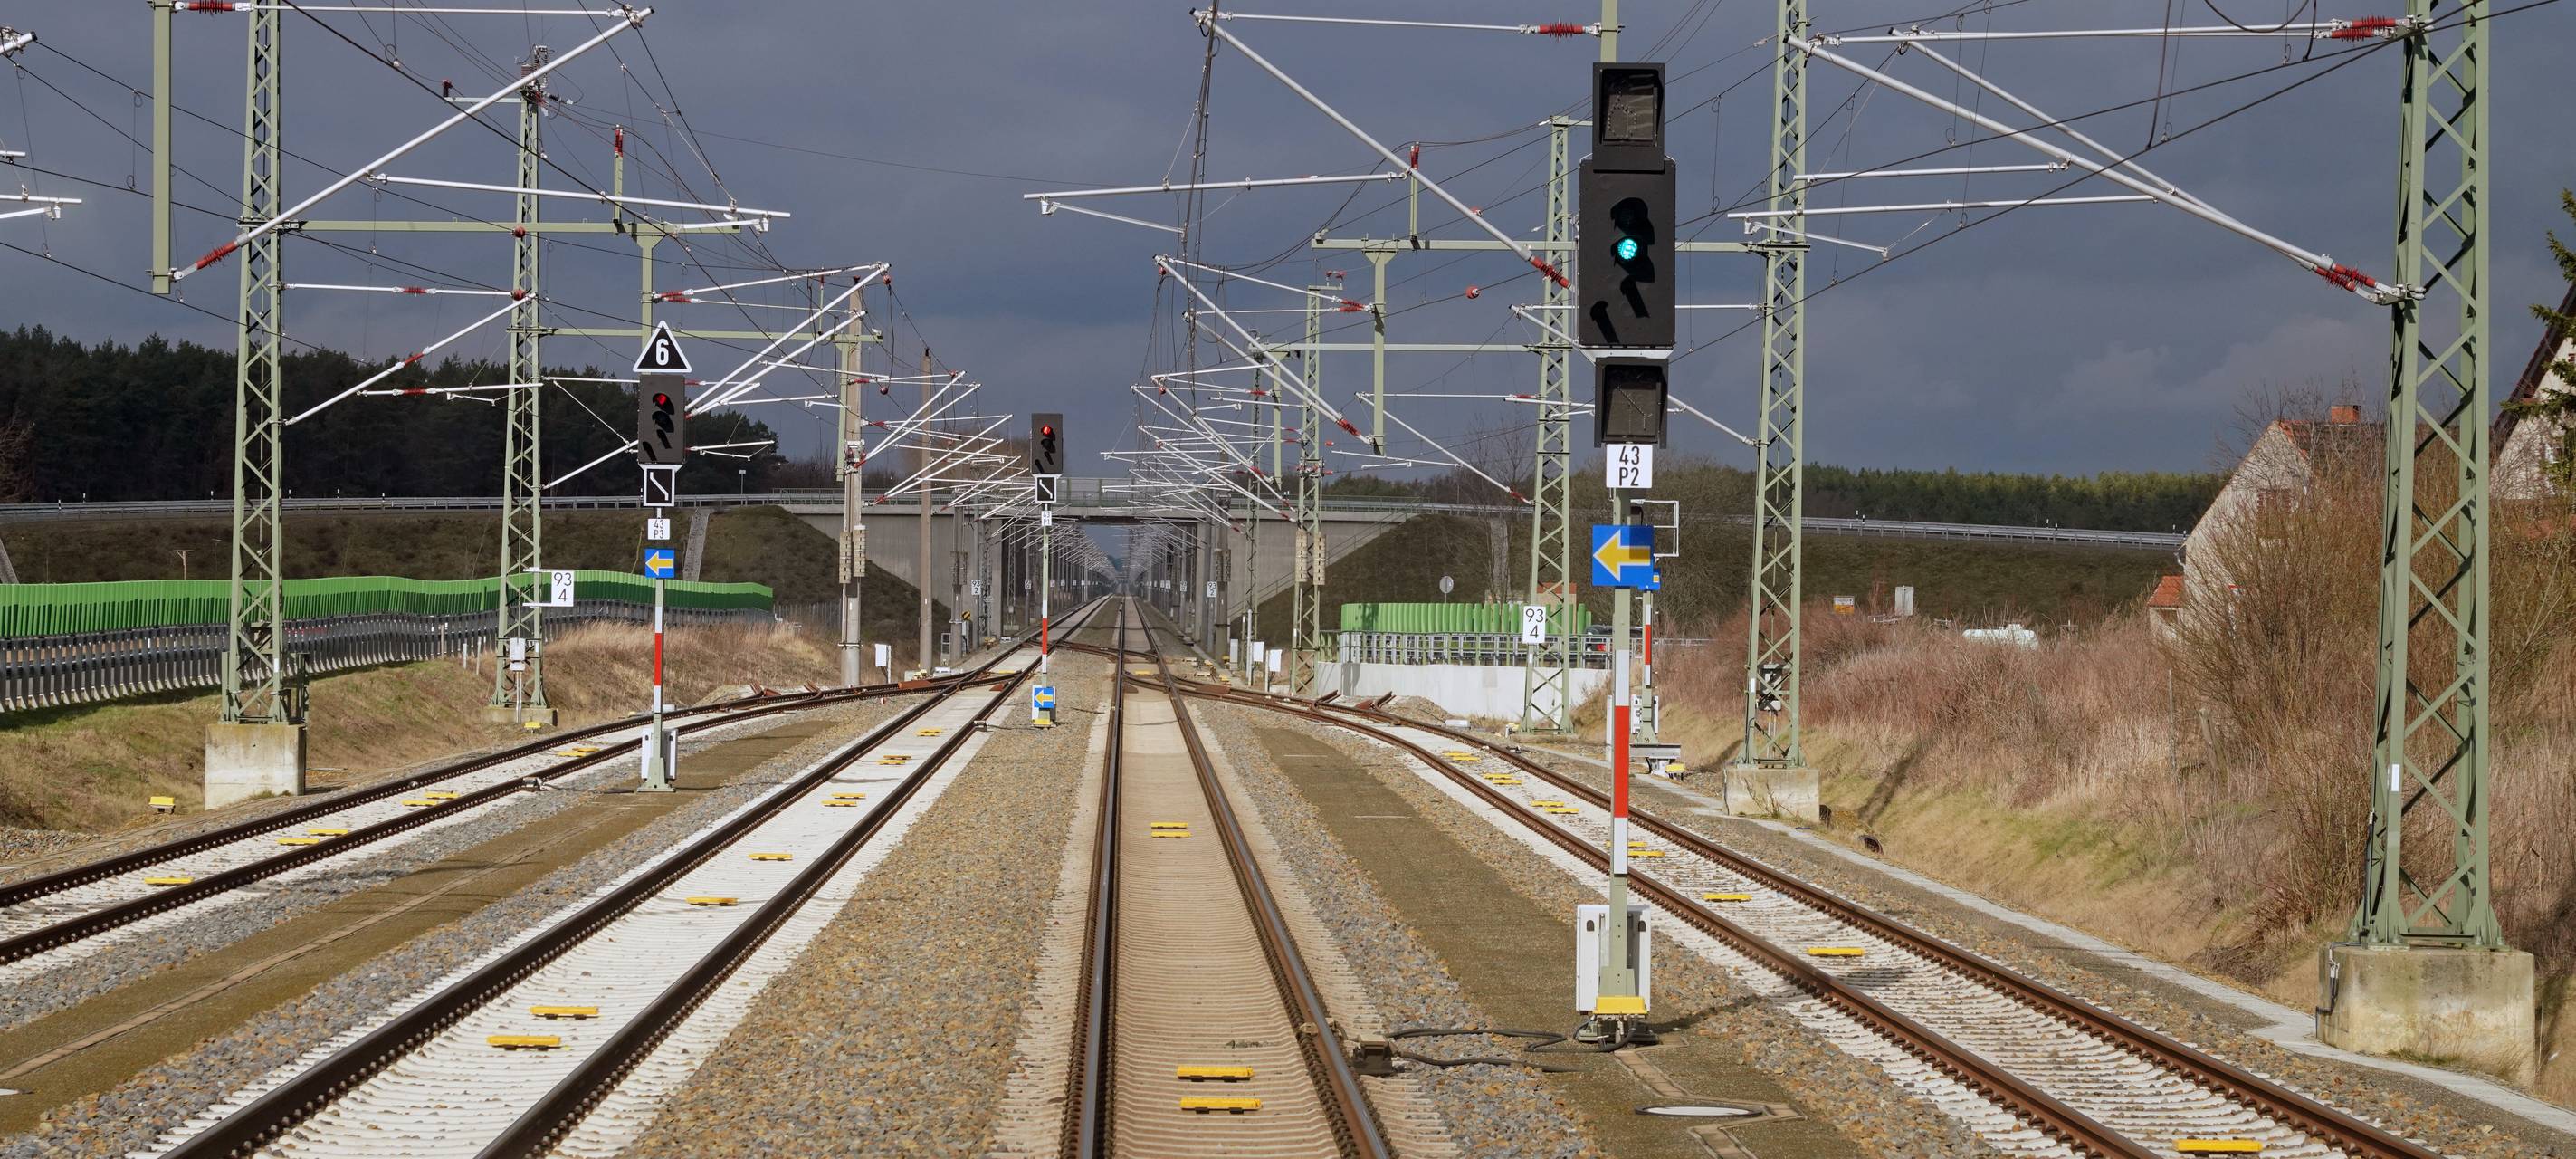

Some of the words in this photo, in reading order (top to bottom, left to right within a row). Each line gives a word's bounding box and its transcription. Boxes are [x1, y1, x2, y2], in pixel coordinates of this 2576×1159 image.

[656, 338, 669, 366] 6
[1619, 445, 1640, 465] 43
[1619, 467, 1639, 486] P2
[654, 520, 664, 529] 43
[654, 530, 664, 539] P3
[554, 572, 572, 587] 93
[558, 588, 568, 602] 4
[1525, 608, 1544, 623] 93
[1530, 625, 1539, 639] 4
